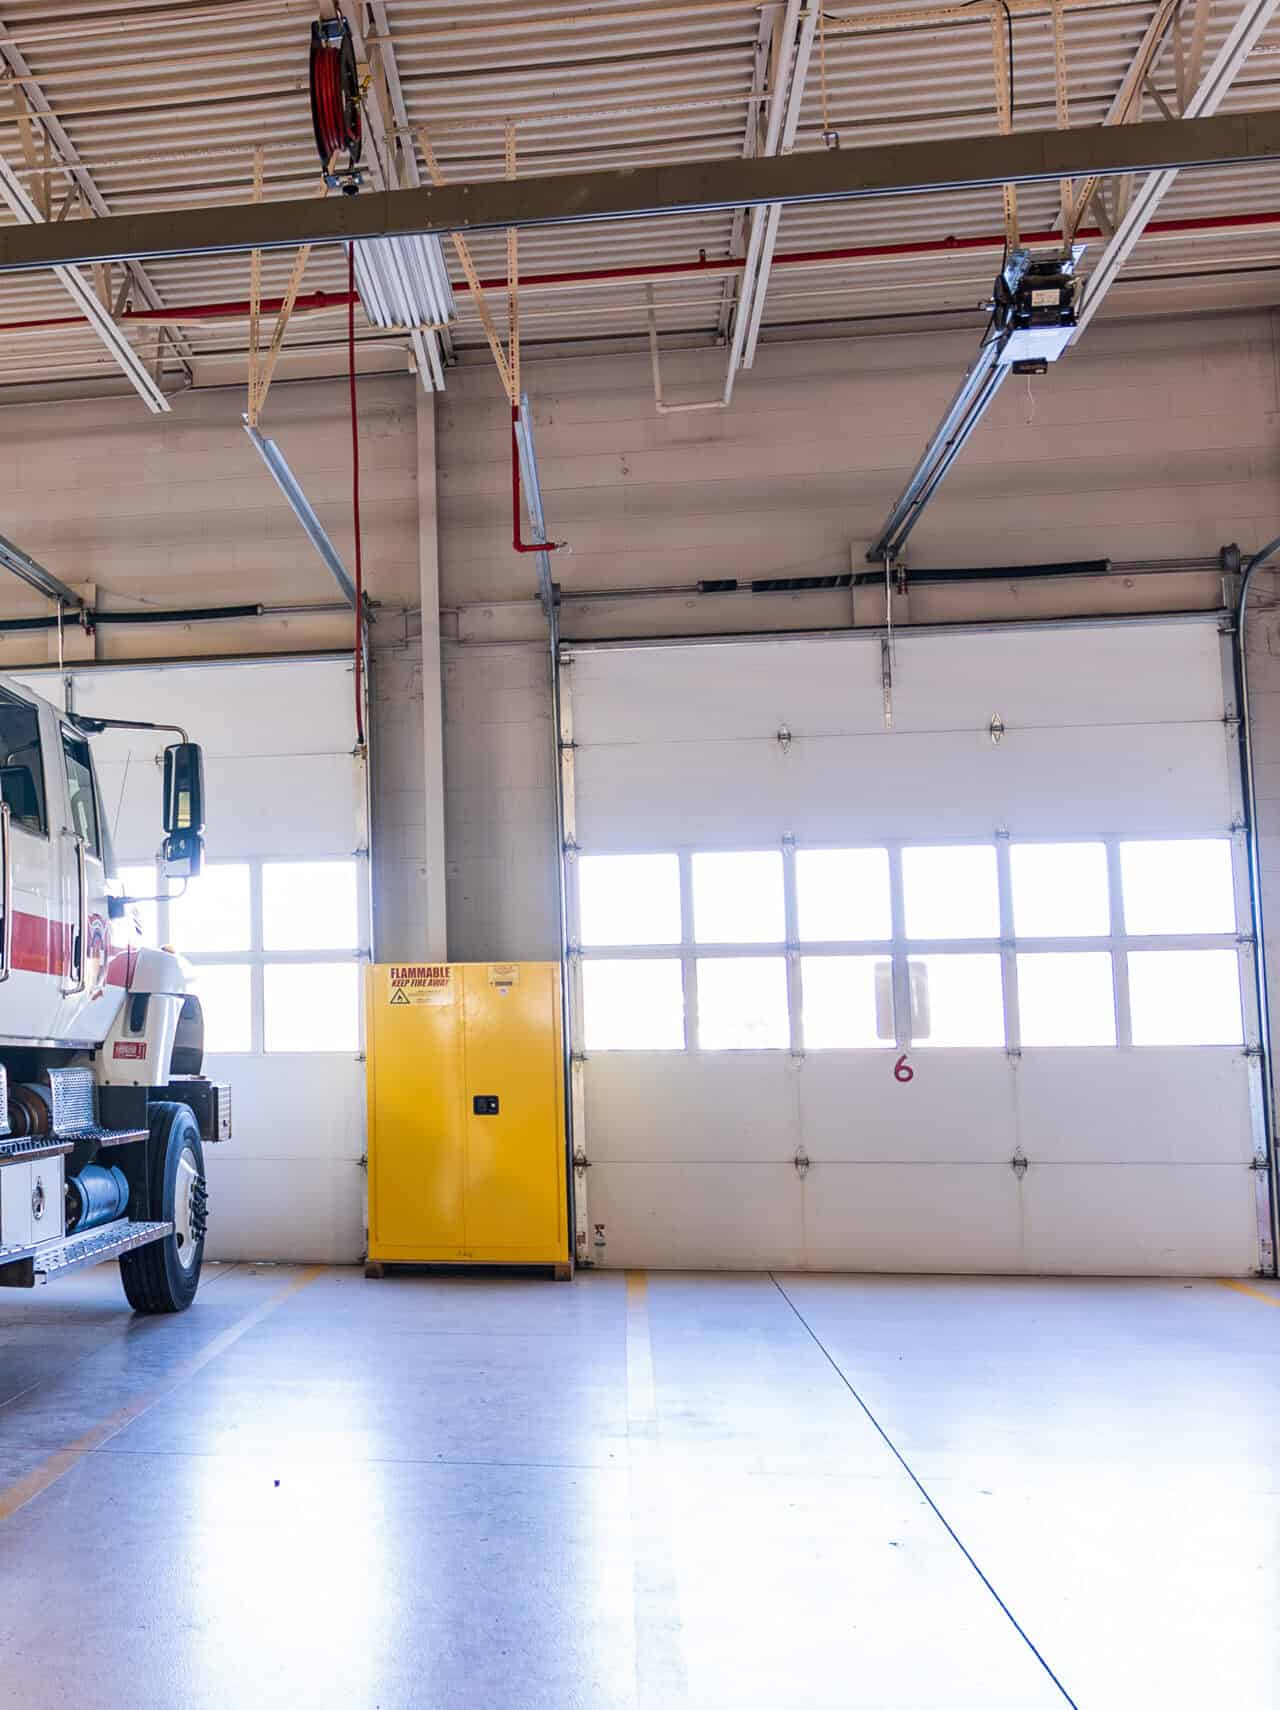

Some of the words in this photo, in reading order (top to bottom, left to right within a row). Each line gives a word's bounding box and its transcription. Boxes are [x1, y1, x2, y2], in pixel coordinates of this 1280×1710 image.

[391, 967, 450, 978] FLAMMABLE
[392, 979, 410, 987] KEEP
[410, 979, 427, 987] FIRE
[894, 1053, 913, 1082] 6
